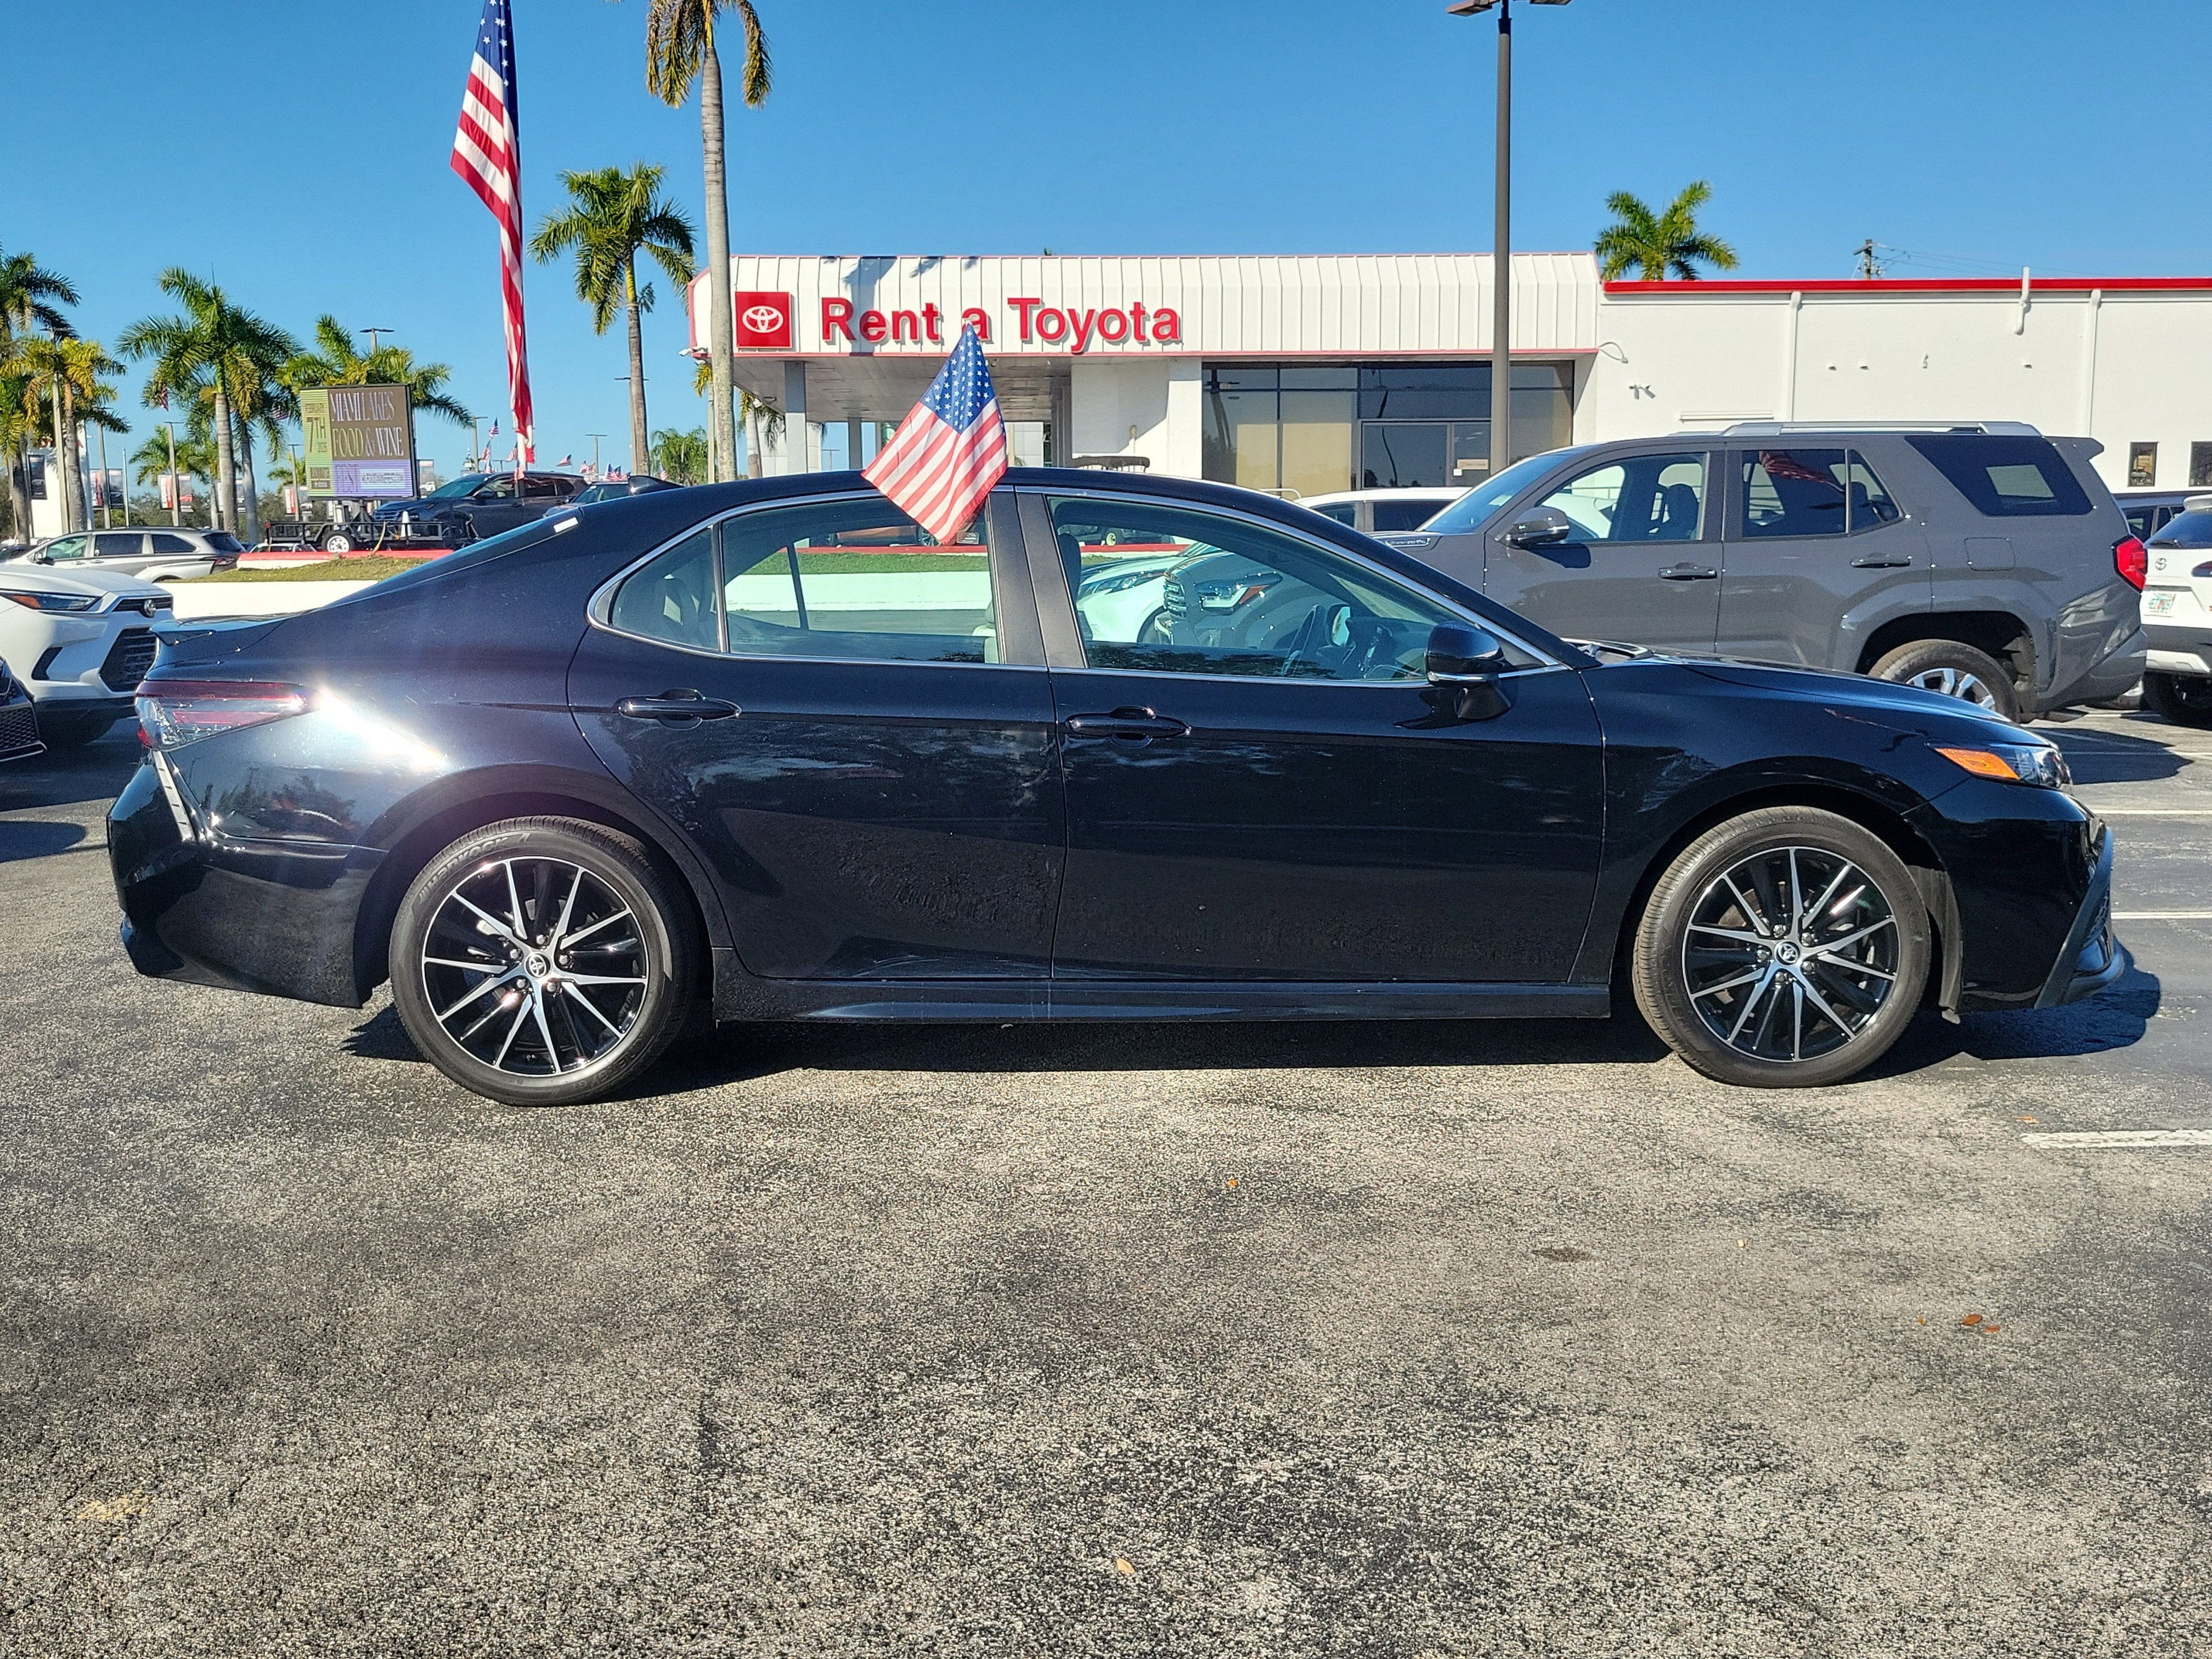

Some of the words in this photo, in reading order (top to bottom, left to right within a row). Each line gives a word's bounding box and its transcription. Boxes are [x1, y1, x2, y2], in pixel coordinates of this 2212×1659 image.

[821, 297, 940, 343] Rent
[961, 307, 990, 341] a
[1007, 297, 1181, 354] Toyota
[329, 392, 362, 422] MIAMI
[362, 391, 395, 421] LAKES
[307, 416, 326, 453] 7TH
[332, 428, 364, 457] FOOD
[365, 427, 375, 457] &
[375, 426, 404, 456] WINE
